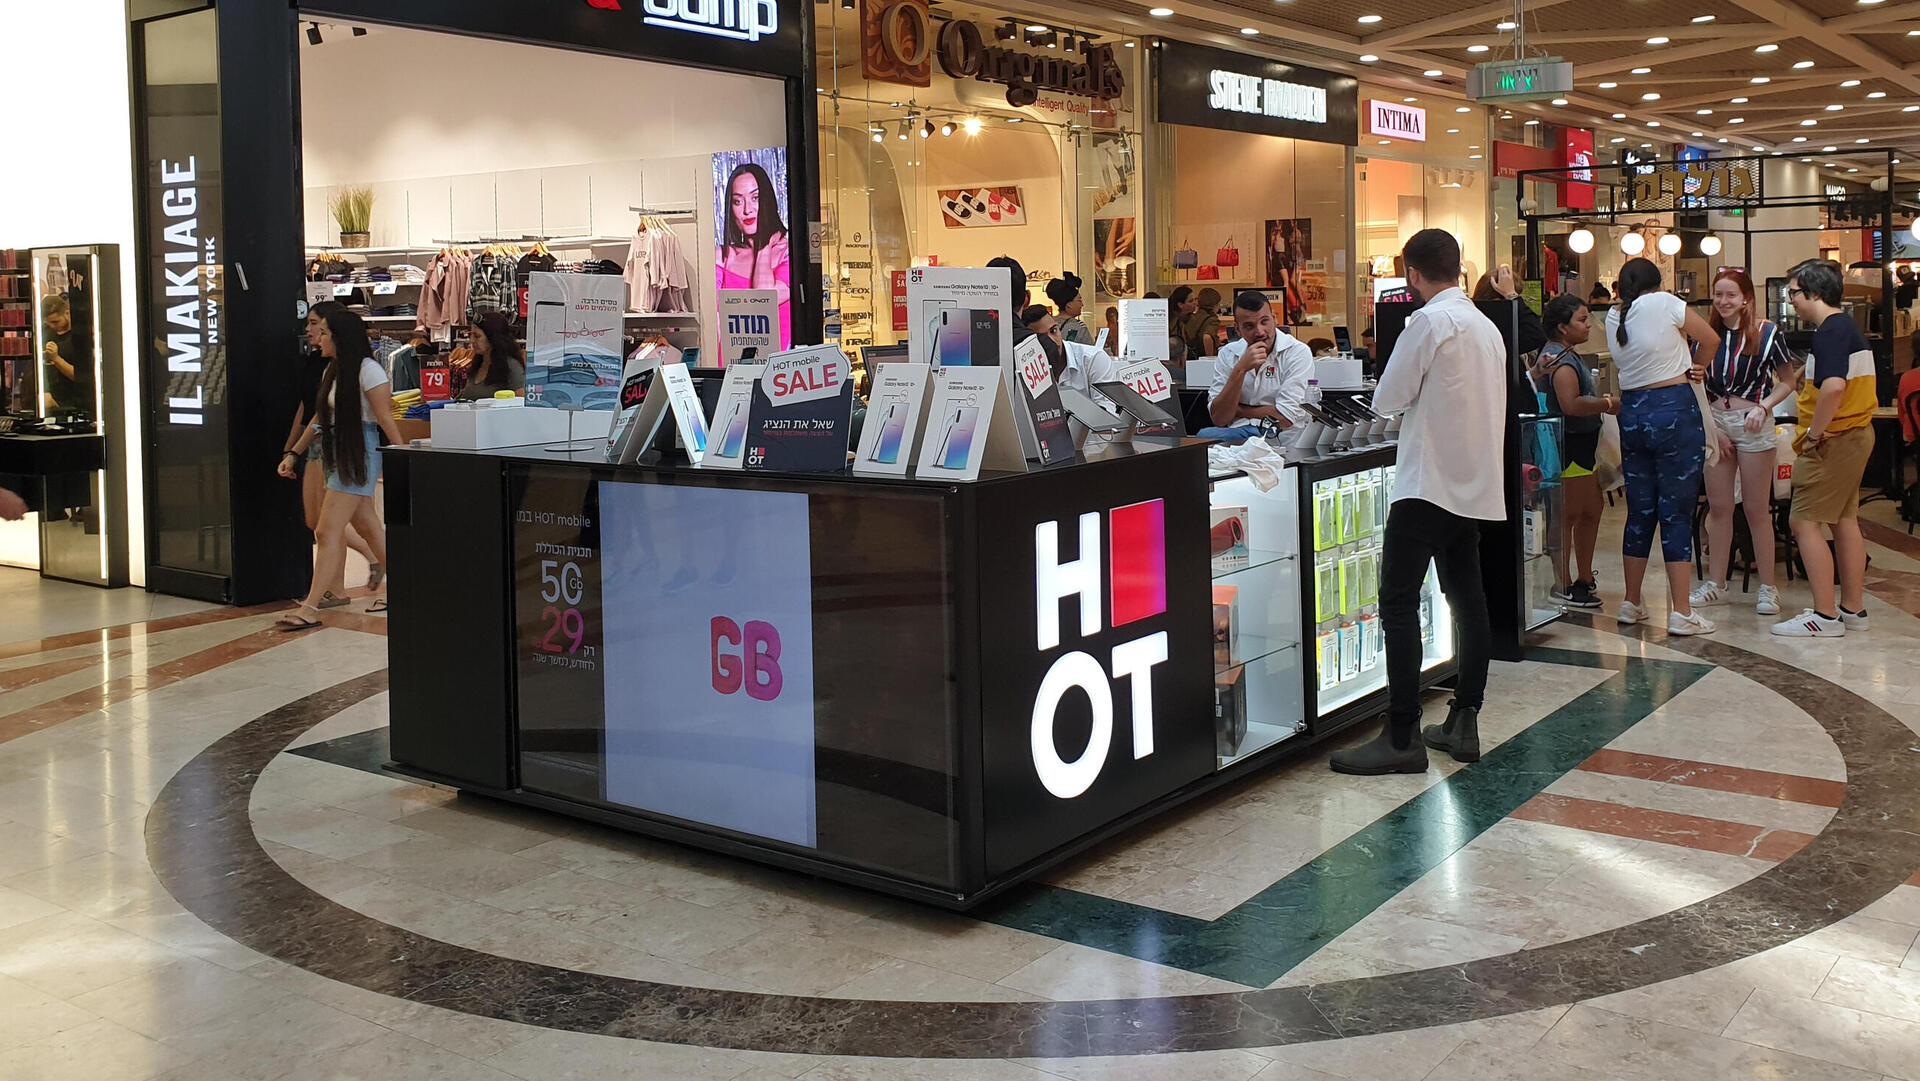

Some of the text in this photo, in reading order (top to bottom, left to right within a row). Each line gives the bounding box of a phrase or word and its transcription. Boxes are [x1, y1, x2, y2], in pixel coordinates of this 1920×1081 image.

[1209, 69, 1327, 124] STEVE MADDEN
[1377, 107, 1420, 134] INTIMA
[161, 155, 204, 426] IL MAKIAGE
[204, 236, 219, 344] NEW YORK
[728, 314, 770, 334] תודה
[772, 360, 791, 372] HOT
[792, 356, 820, 368] mobile
[1025, 354, 1048, 389] SALE
[1122, 367, 1150, 380] HOT mobile
[426, 372, 443, 386] 79
[772, 362, 839, 397] SALE
[624, 383, 648, 404] SAL
[763, 418, 834, 430] שאל את הנציג
[534, 512, 555, 524] HOT
[557, 514, 591, 528] mobile
[536, 542, 592, 558] תכנית הכוללת
[542, 606, 584, 654] 29
[549, 654, 569, 666] למשך
[584, 646, 595, 657] רק
[710, 616, 783, 701] GB
[1031, 630, 1168, 799] OT
